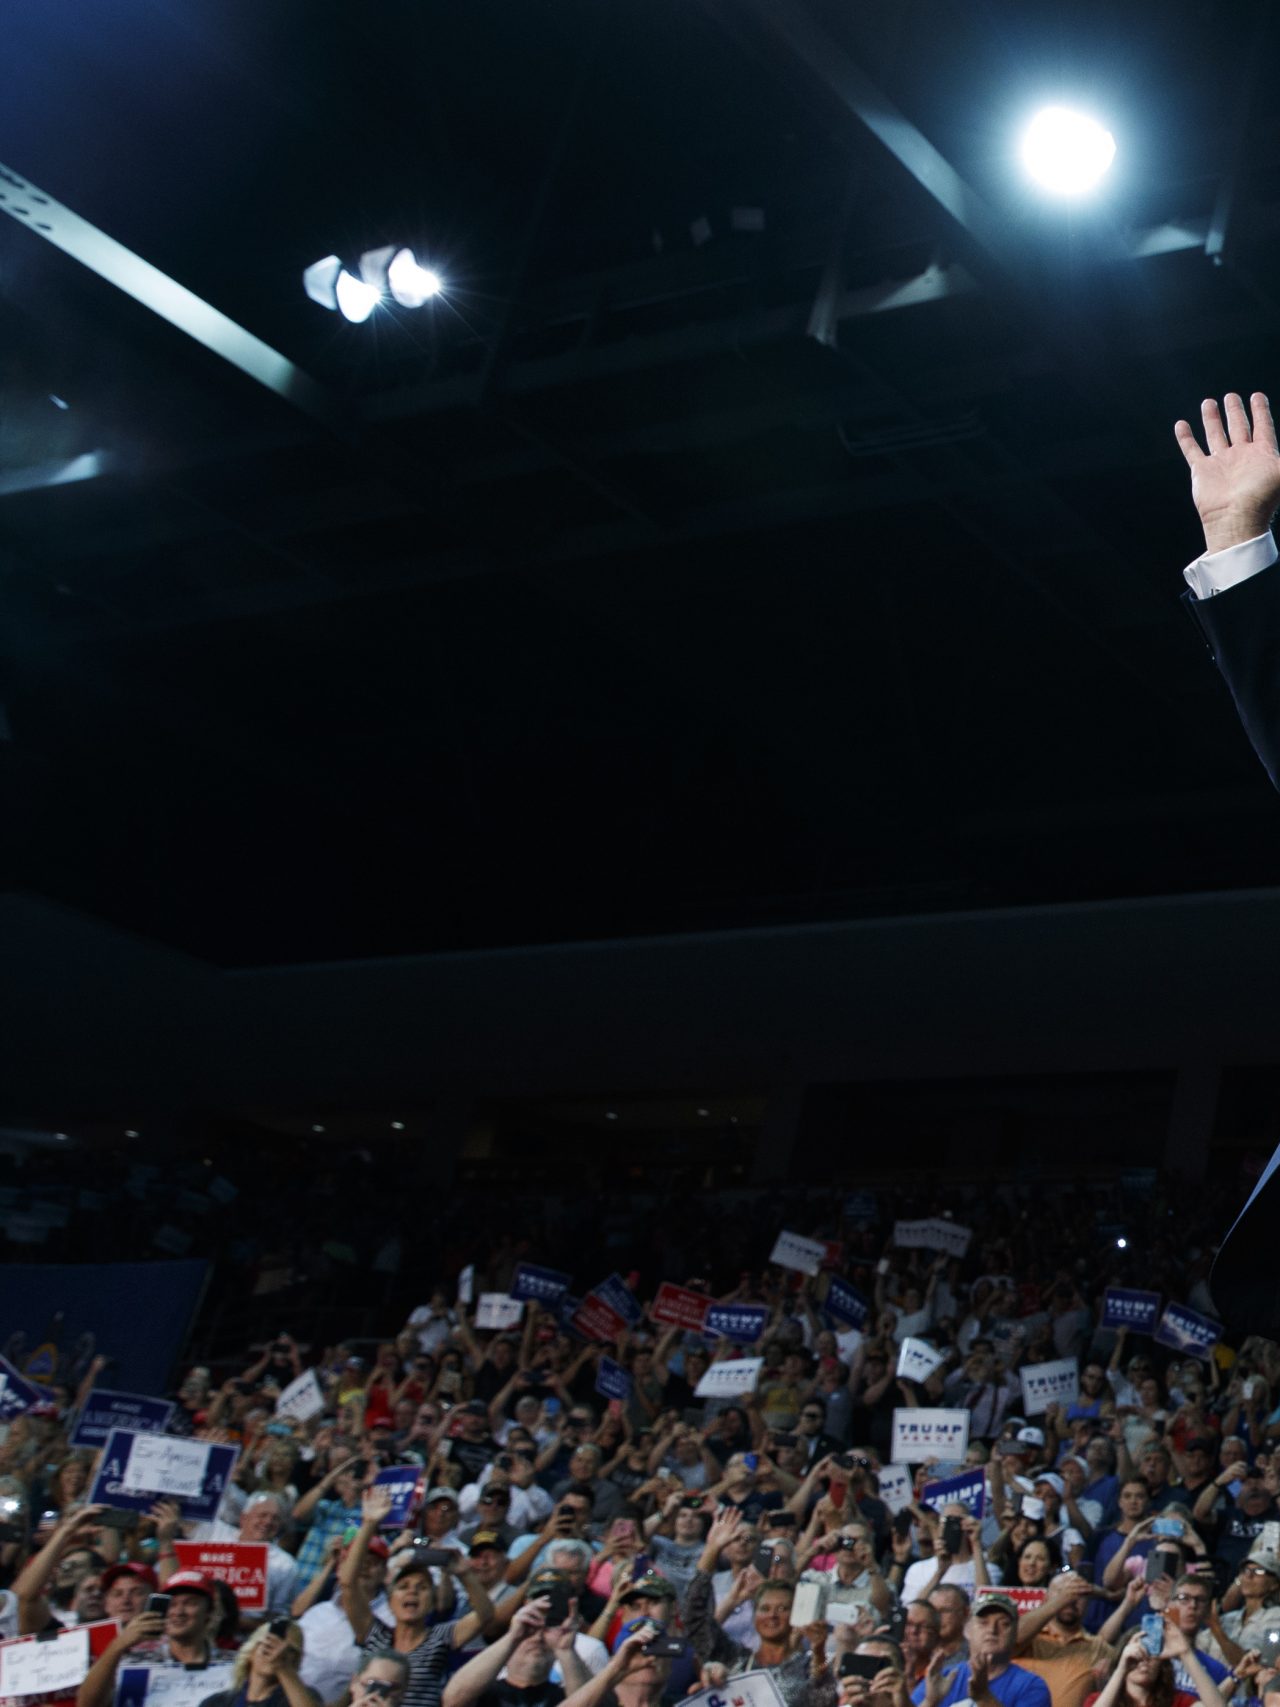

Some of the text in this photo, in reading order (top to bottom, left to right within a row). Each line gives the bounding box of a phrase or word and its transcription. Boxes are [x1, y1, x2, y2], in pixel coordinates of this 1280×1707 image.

[1107, 1298, 1156, 1311] TRUMP
[710, 1312, 763, 1324] TRUMP
[1167, 1312, 1217, 1338] TRUMP
[1027, 1371, 1076, 1389] TRUMP
[899, 1424, 963, 1434] TRUMP
[199, 1552, 236, 1563] MAKE
[1018, 1599, 1045, 1611] AKE
